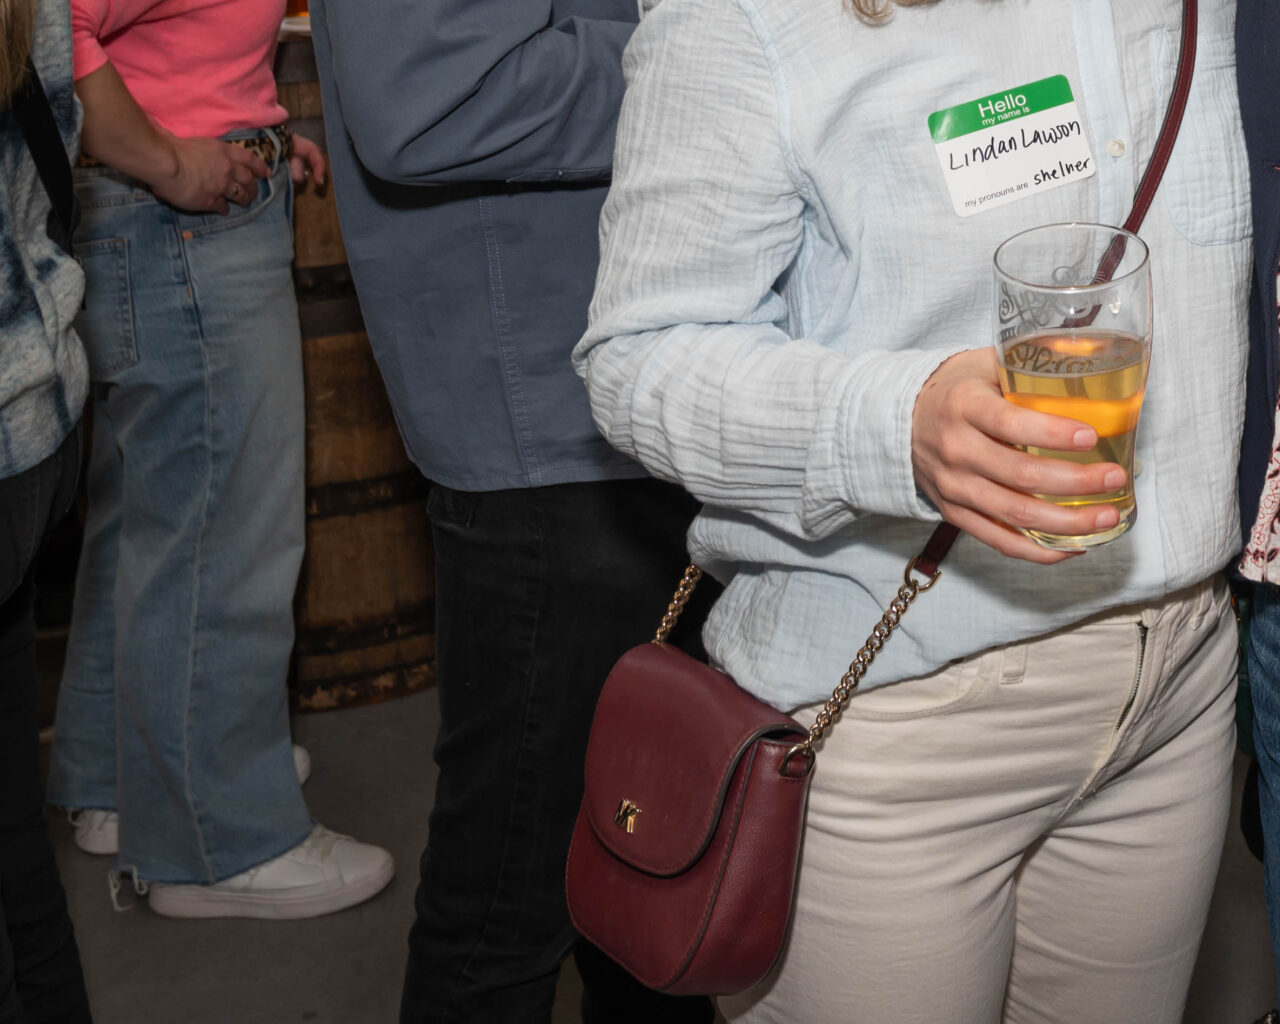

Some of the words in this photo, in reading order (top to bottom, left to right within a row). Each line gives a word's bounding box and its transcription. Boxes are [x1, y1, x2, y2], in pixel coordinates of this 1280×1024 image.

[978, 93, 1027, 118] Hello
[982, 117, 996, 127] my
[997, 110, 1021, 122] name
[1022, 106, 1030, 114] is
[964, 199, 977, 208] my
[978, 186, 1015, 205] pronouns
[1016, 182, 1029, 192] are
